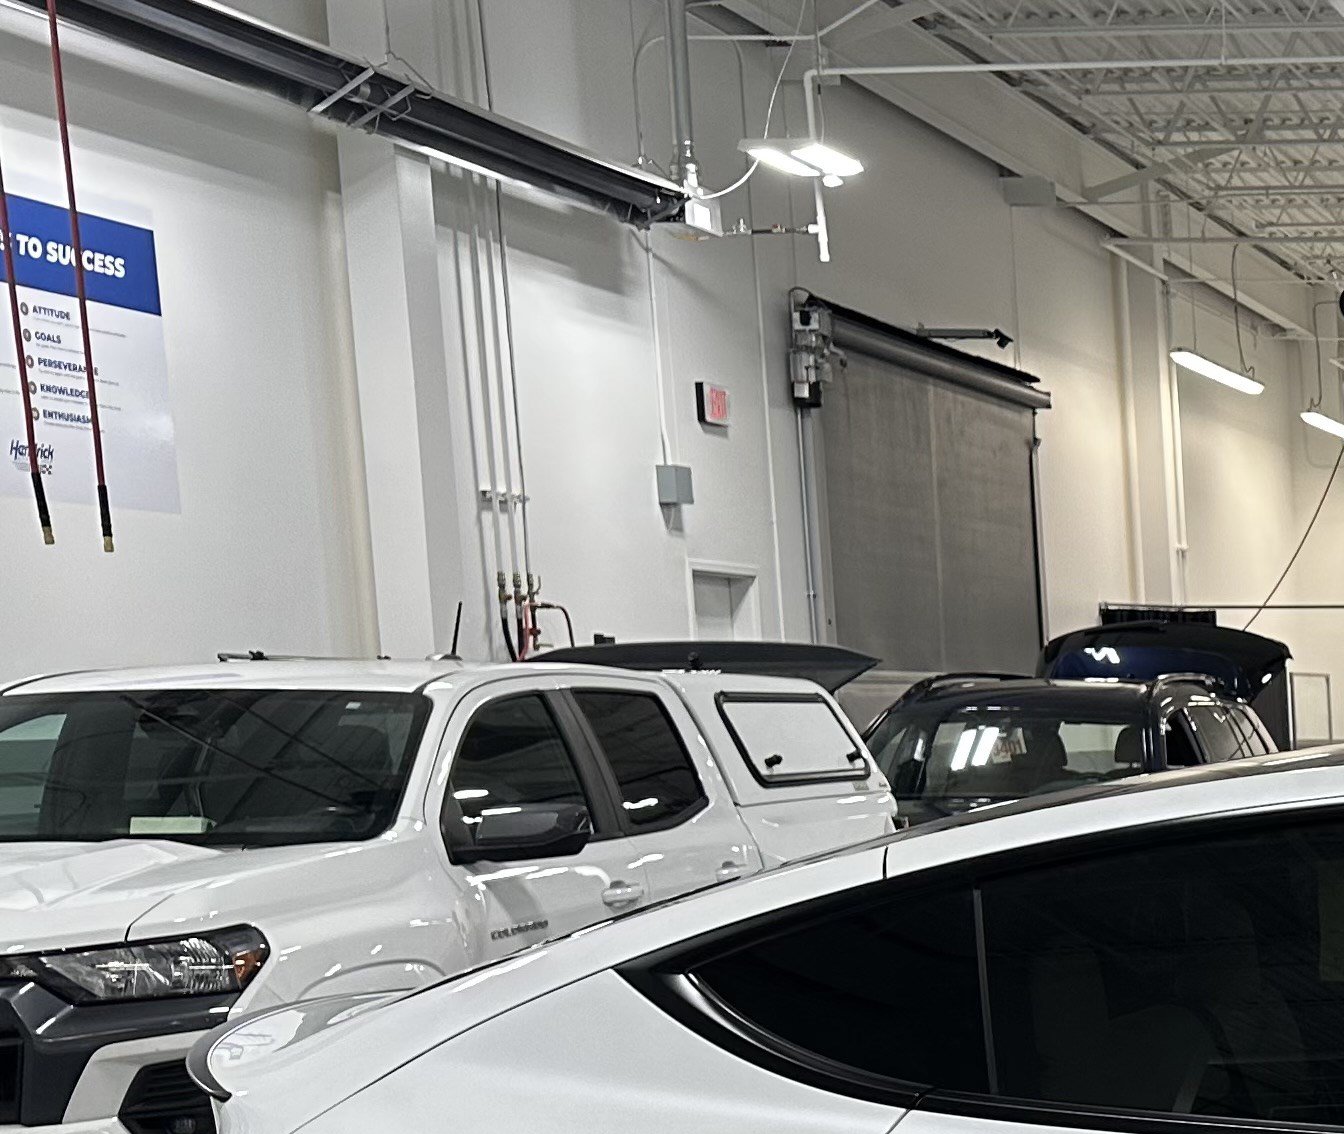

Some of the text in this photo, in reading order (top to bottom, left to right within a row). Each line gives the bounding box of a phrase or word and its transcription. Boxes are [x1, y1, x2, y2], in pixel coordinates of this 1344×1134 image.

[16, 233, 43, 259] TO
[32, 305, 70, 321] ATTITUDE
[34, 331, 62, 344] GOALS
